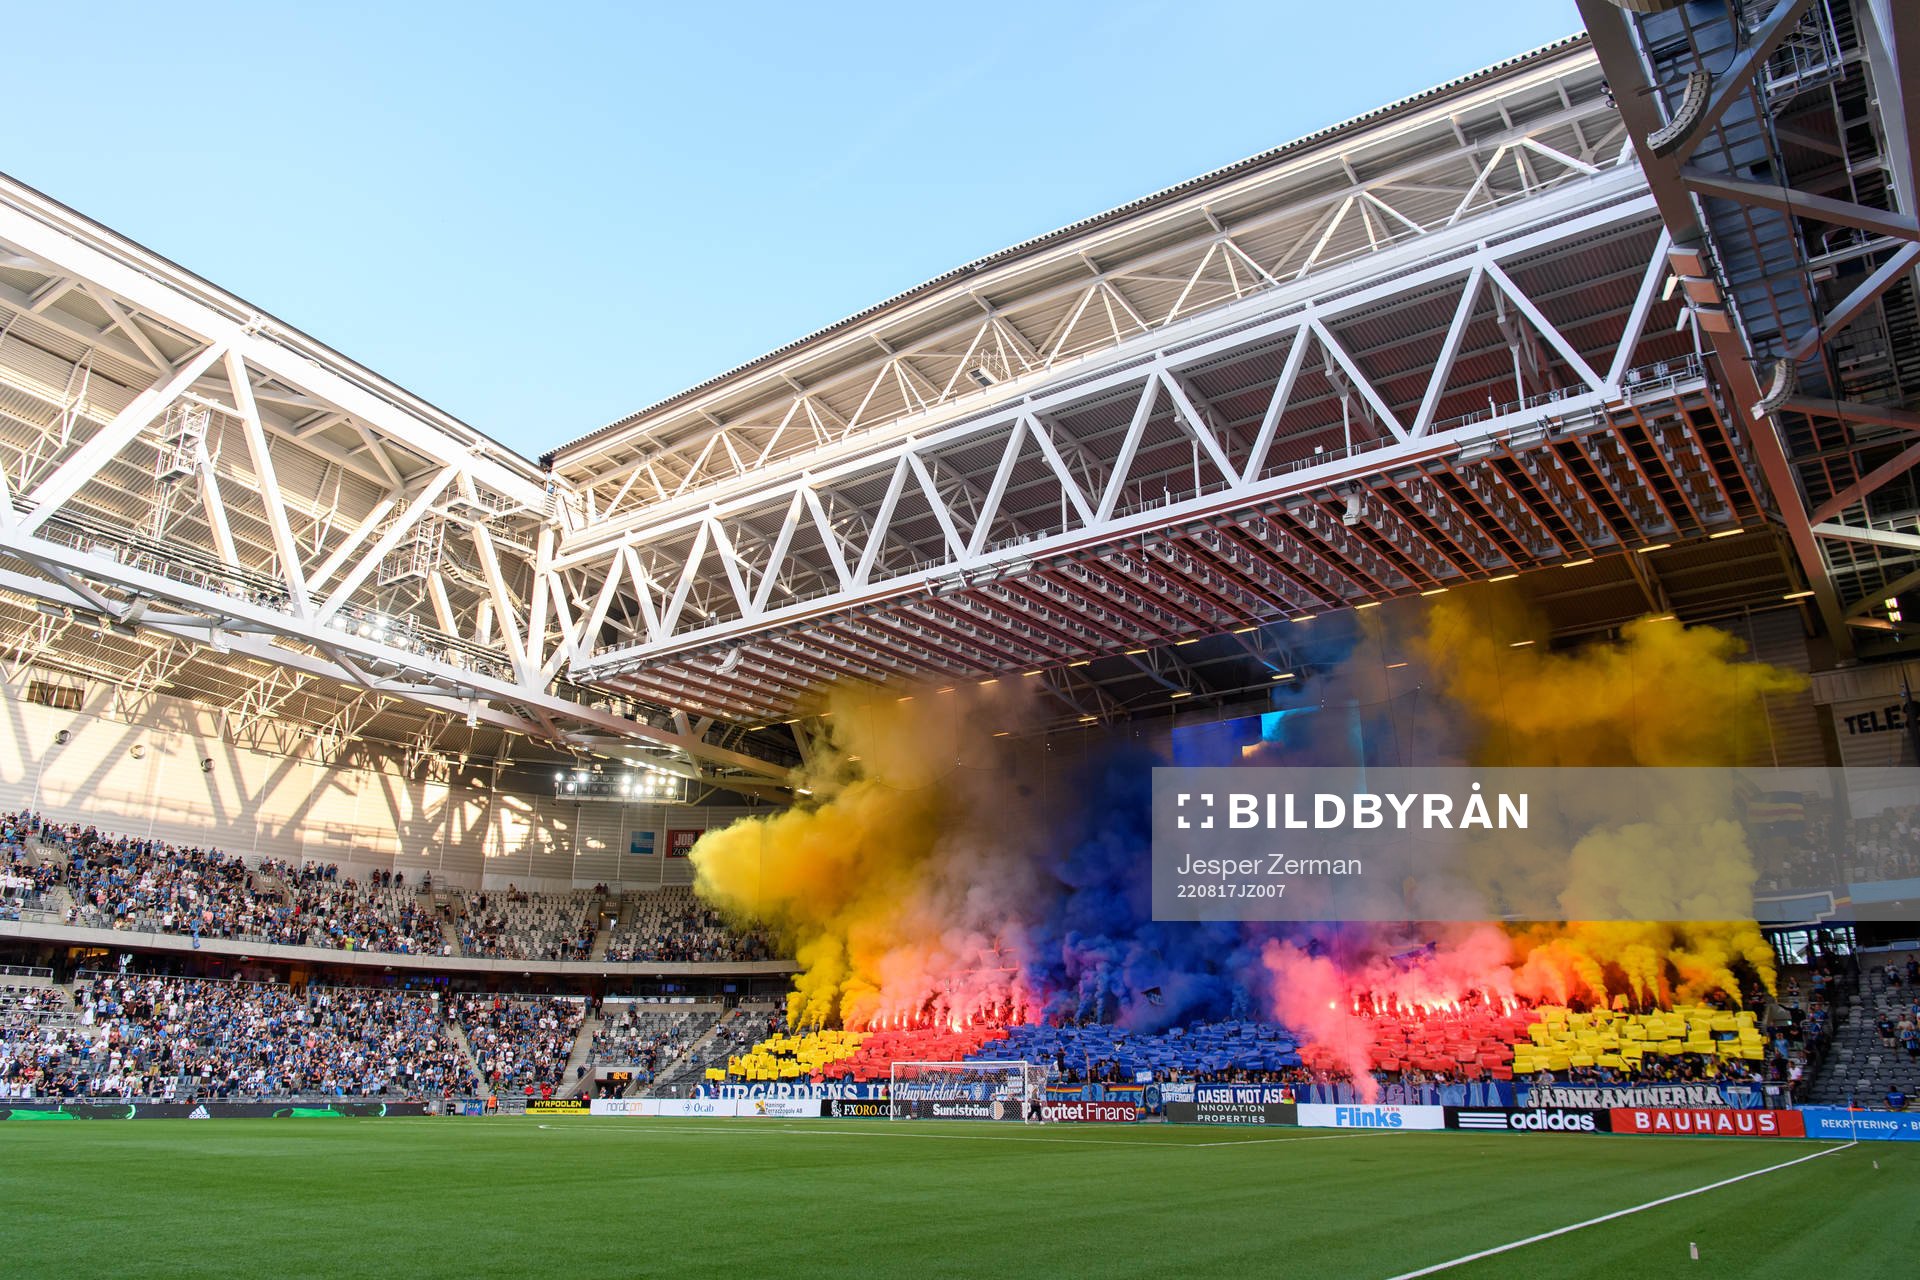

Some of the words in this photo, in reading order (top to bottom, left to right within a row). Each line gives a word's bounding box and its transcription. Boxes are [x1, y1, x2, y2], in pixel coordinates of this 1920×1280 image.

[674, 833, 694, 846] JOB
[1198, 1089, 1234, 1104] OASEN
[1236, 1089, 1261, 1104] MOT
[1528, 1085, 1724, 1109] JÄRNKAMINERNA
[534, 1100, 582, 1108] HYRPOOLEN
[932, 1103, 989, 1116] Sundström
[1196, 1104, 1265, 1112] INNOVATION
[1086, 1102, 1135, 1121] Finans
[1335, 1107, 1402, 1127] Flinks
[1197, 1114, 1266, 1124] PROPERTIES
[1510, 1109, 1595, 1131] adidas
[1634, 1112, 1775, 1132] BAUHAUS
[1821, 1119, 1899, 1130] REKRYTERING
